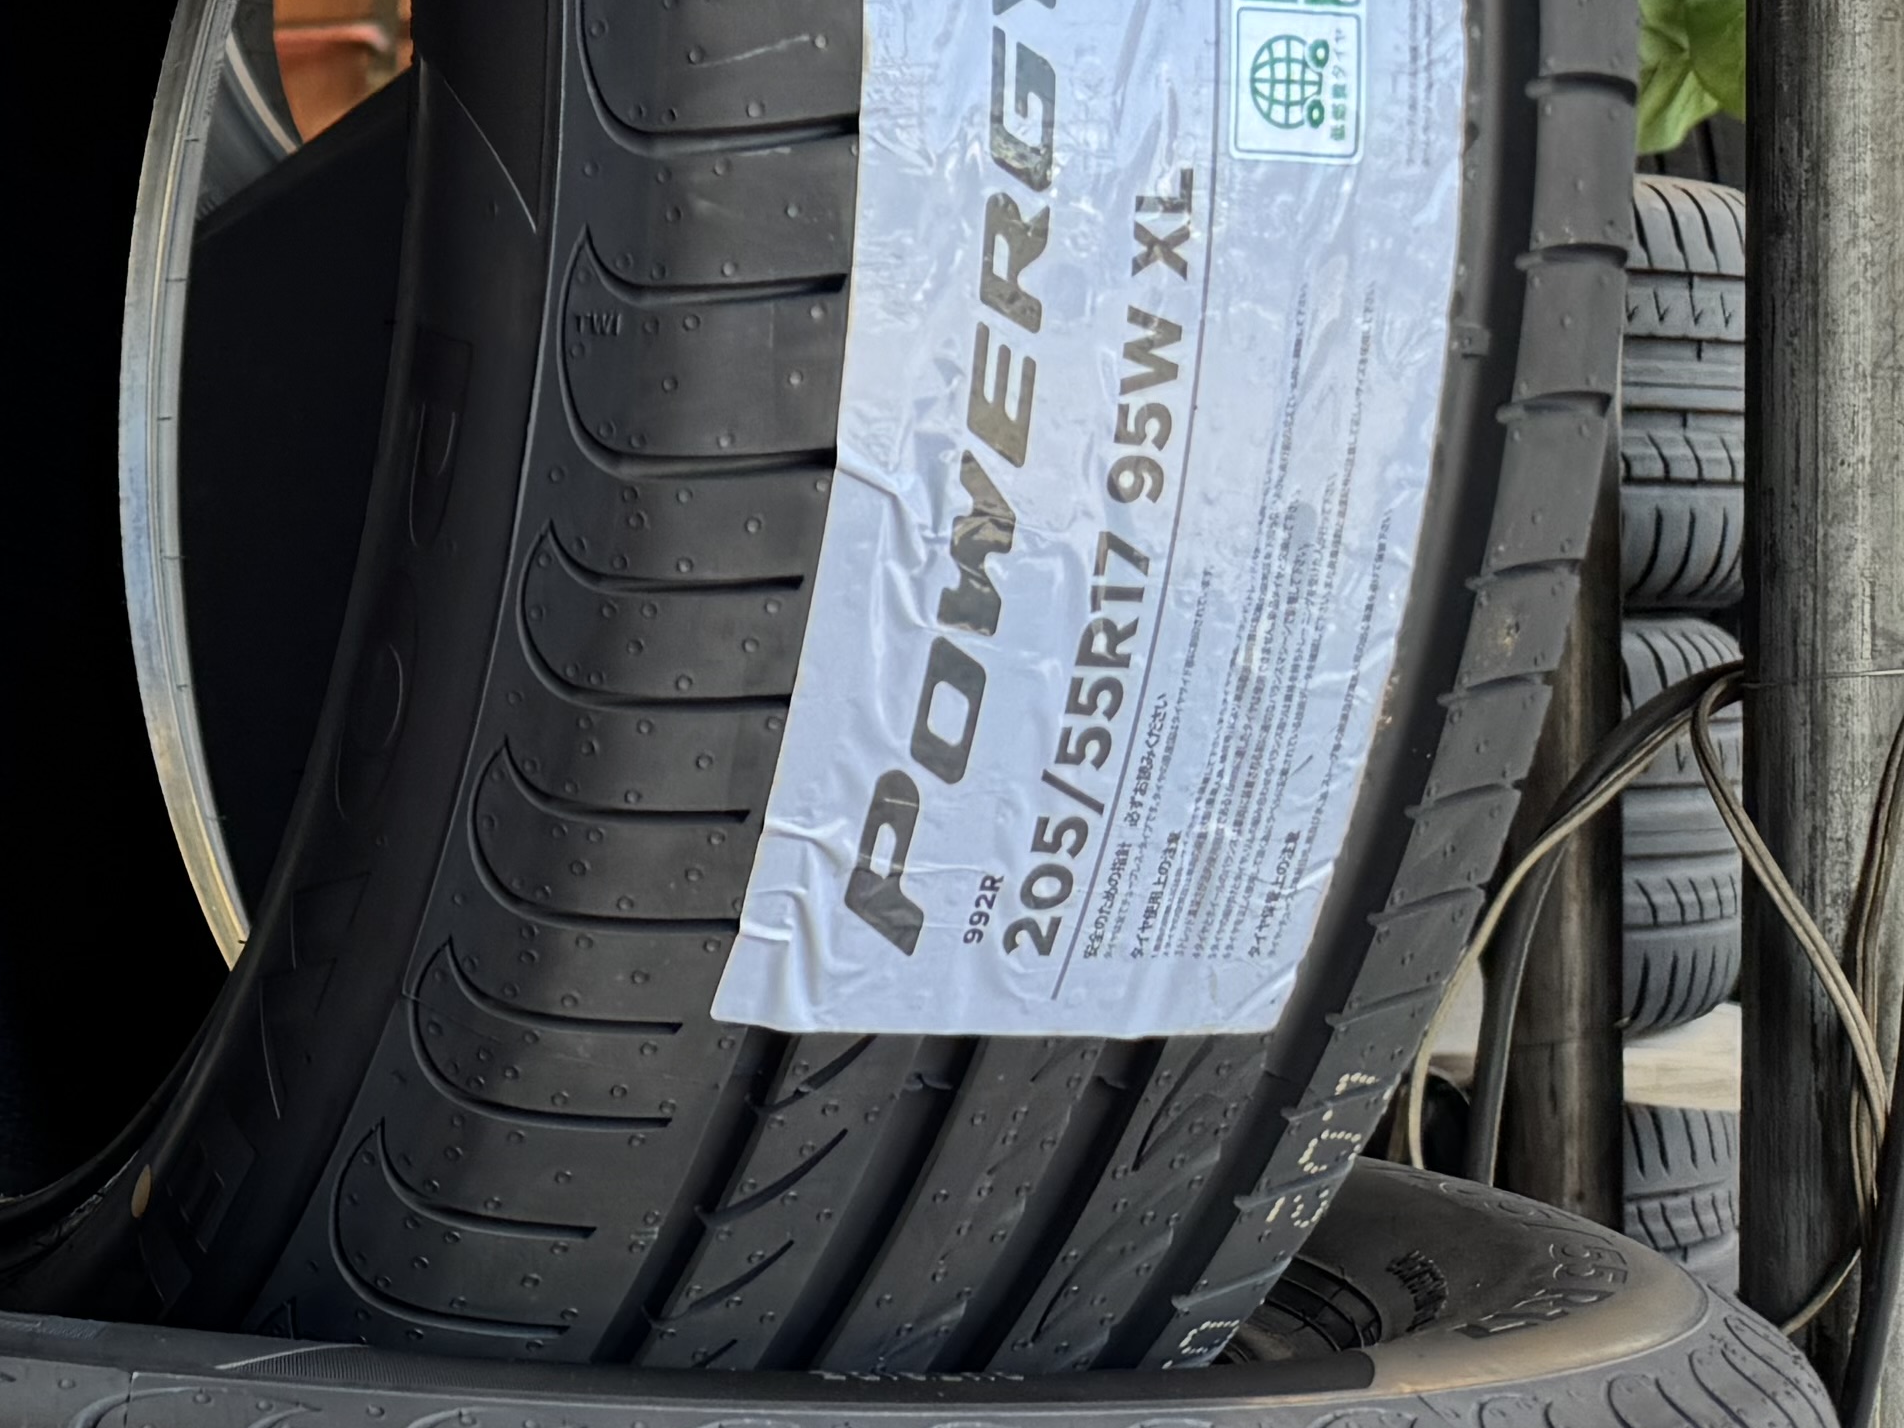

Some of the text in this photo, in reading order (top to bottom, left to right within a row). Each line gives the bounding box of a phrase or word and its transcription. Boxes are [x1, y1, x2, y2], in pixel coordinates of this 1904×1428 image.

[1131, 168, 1193, 279] XL
[1105, 304, 1184, 504] 95W
[1003, 531, 1153, 958] 205/55R17
[1084, 692, 1170, 960] 安全のための指針 必ずお読みください
[963, 874, 1003, 944] 992R
